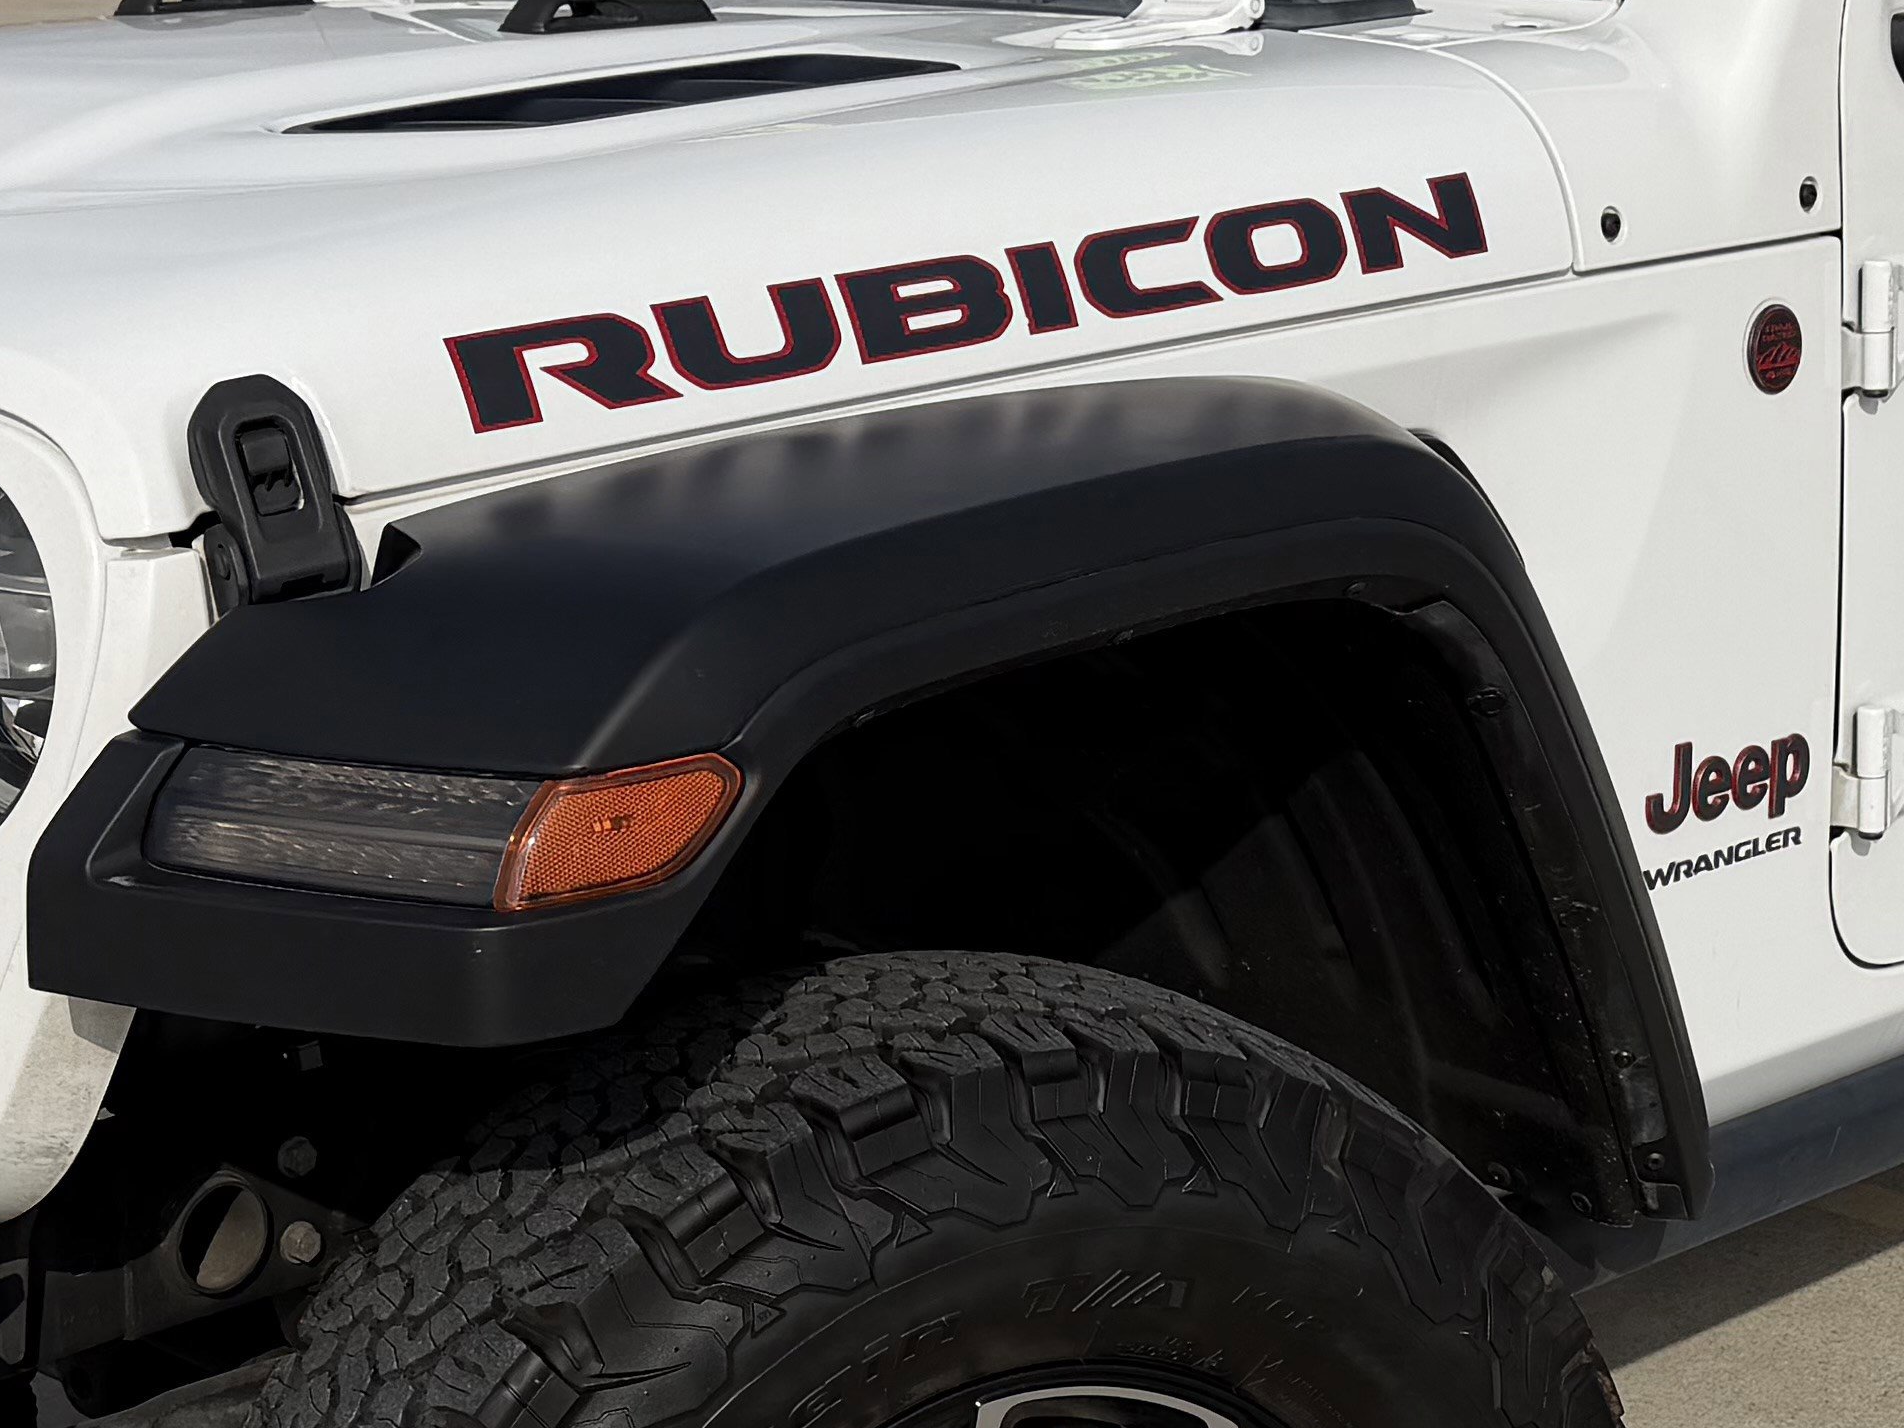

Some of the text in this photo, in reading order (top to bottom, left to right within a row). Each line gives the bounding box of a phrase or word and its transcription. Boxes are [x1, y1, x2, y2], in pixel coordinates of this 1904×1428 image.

[442, 172, 1489, 435] RUBICON
[1645, 732, 1811, 835] Jeep
[1642, 825, 1802, 891] WRANGLER
